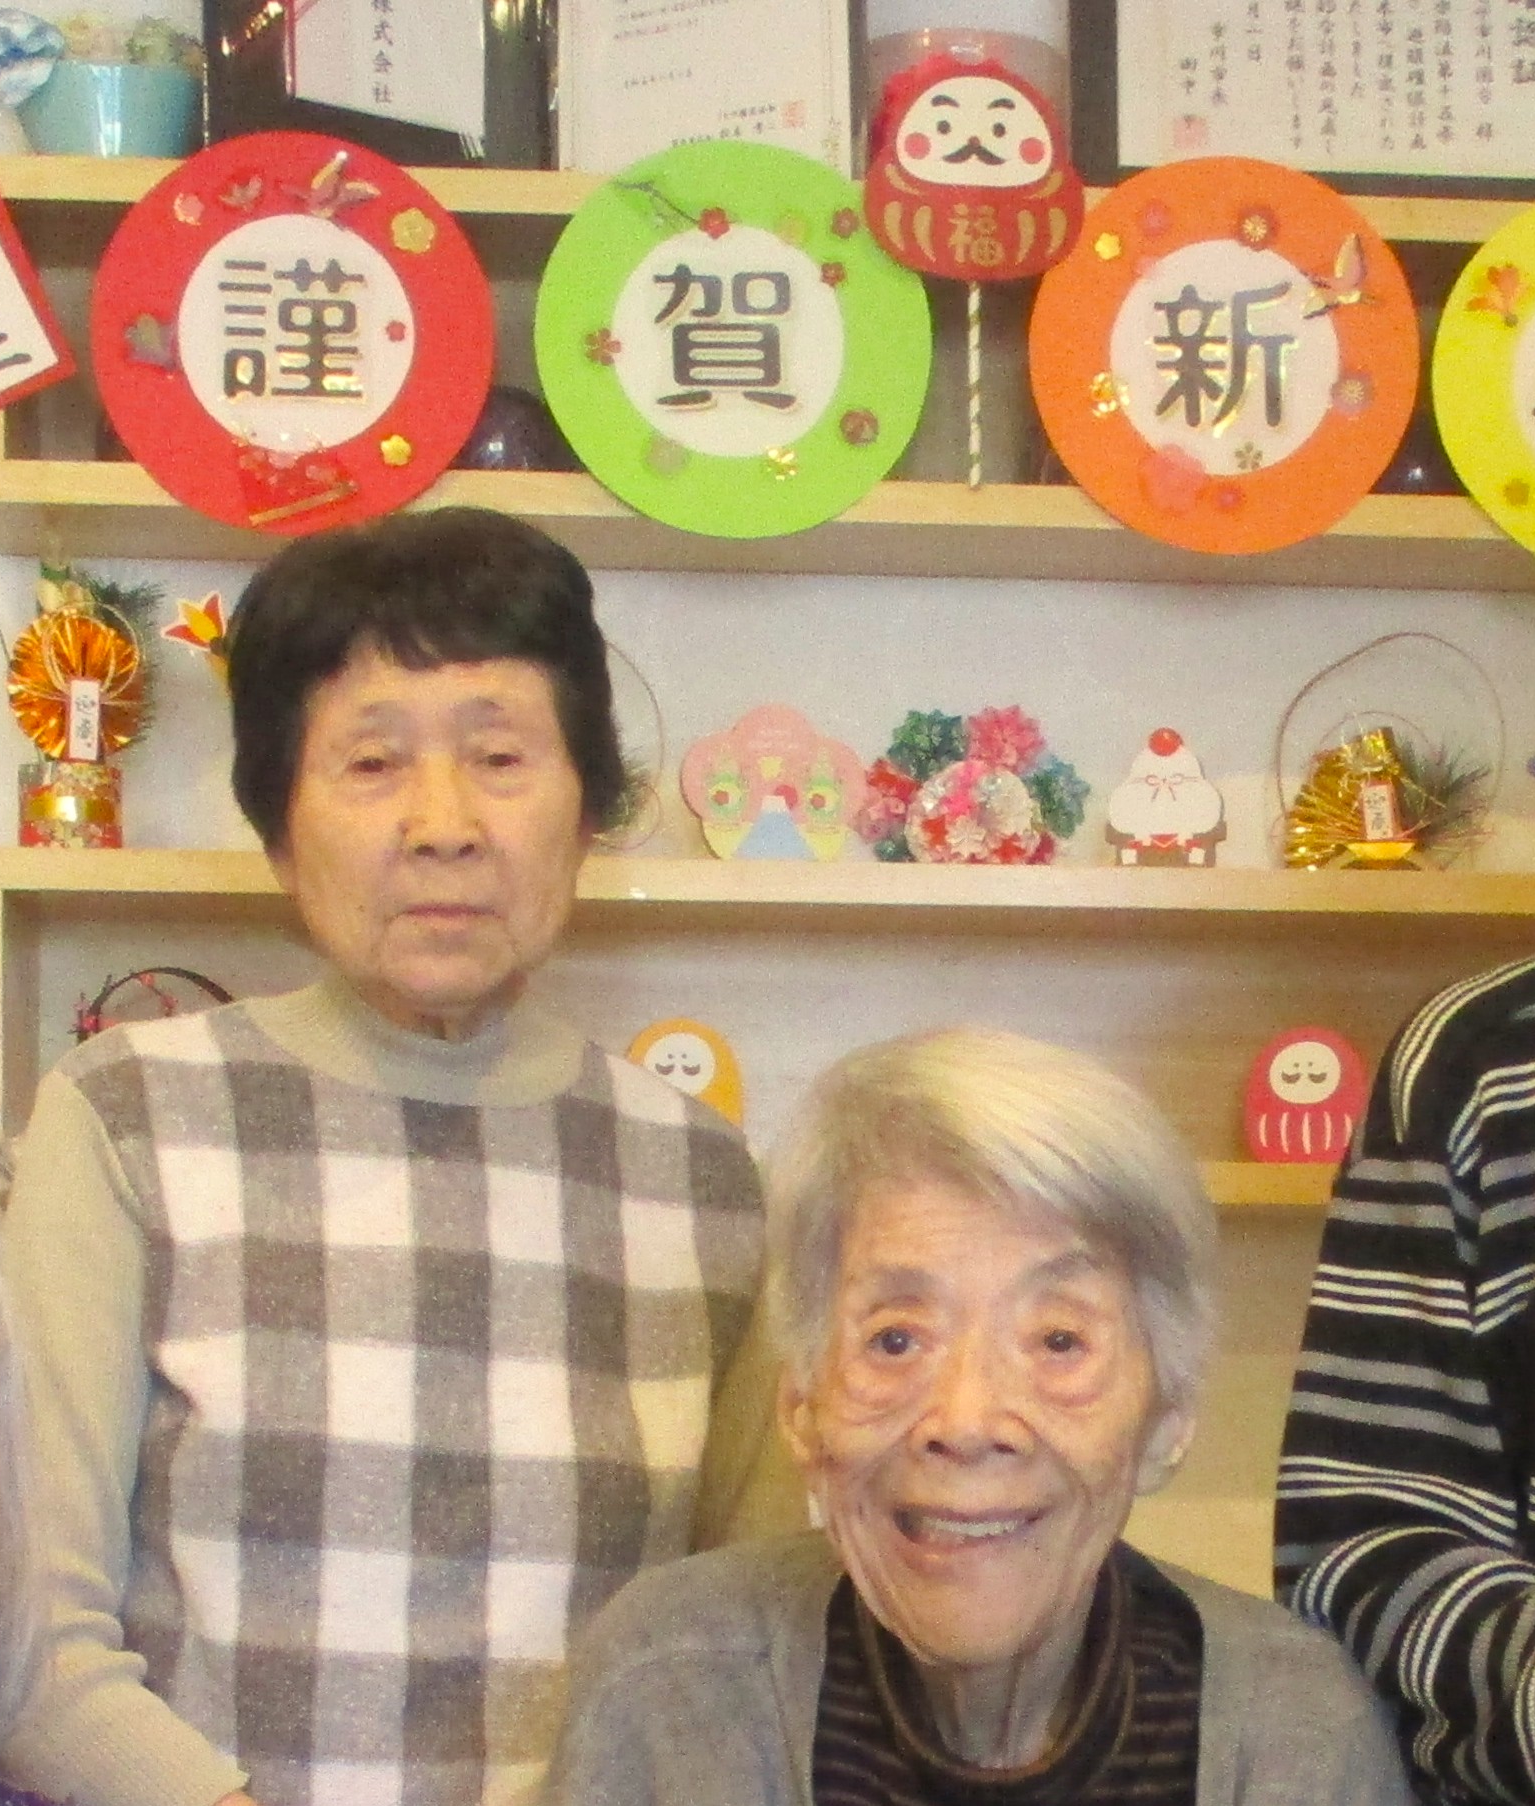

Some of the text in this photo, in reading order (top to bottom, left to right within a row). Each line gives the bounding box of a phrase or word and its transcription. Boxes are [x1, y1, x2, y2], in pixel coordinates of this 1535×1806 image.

[947, 202, 1006, 268] 福
[218, 257, 368, 403] 謹
[653, 263, 798, 411] 賀
[1153, 281, 1299, 430] 新
